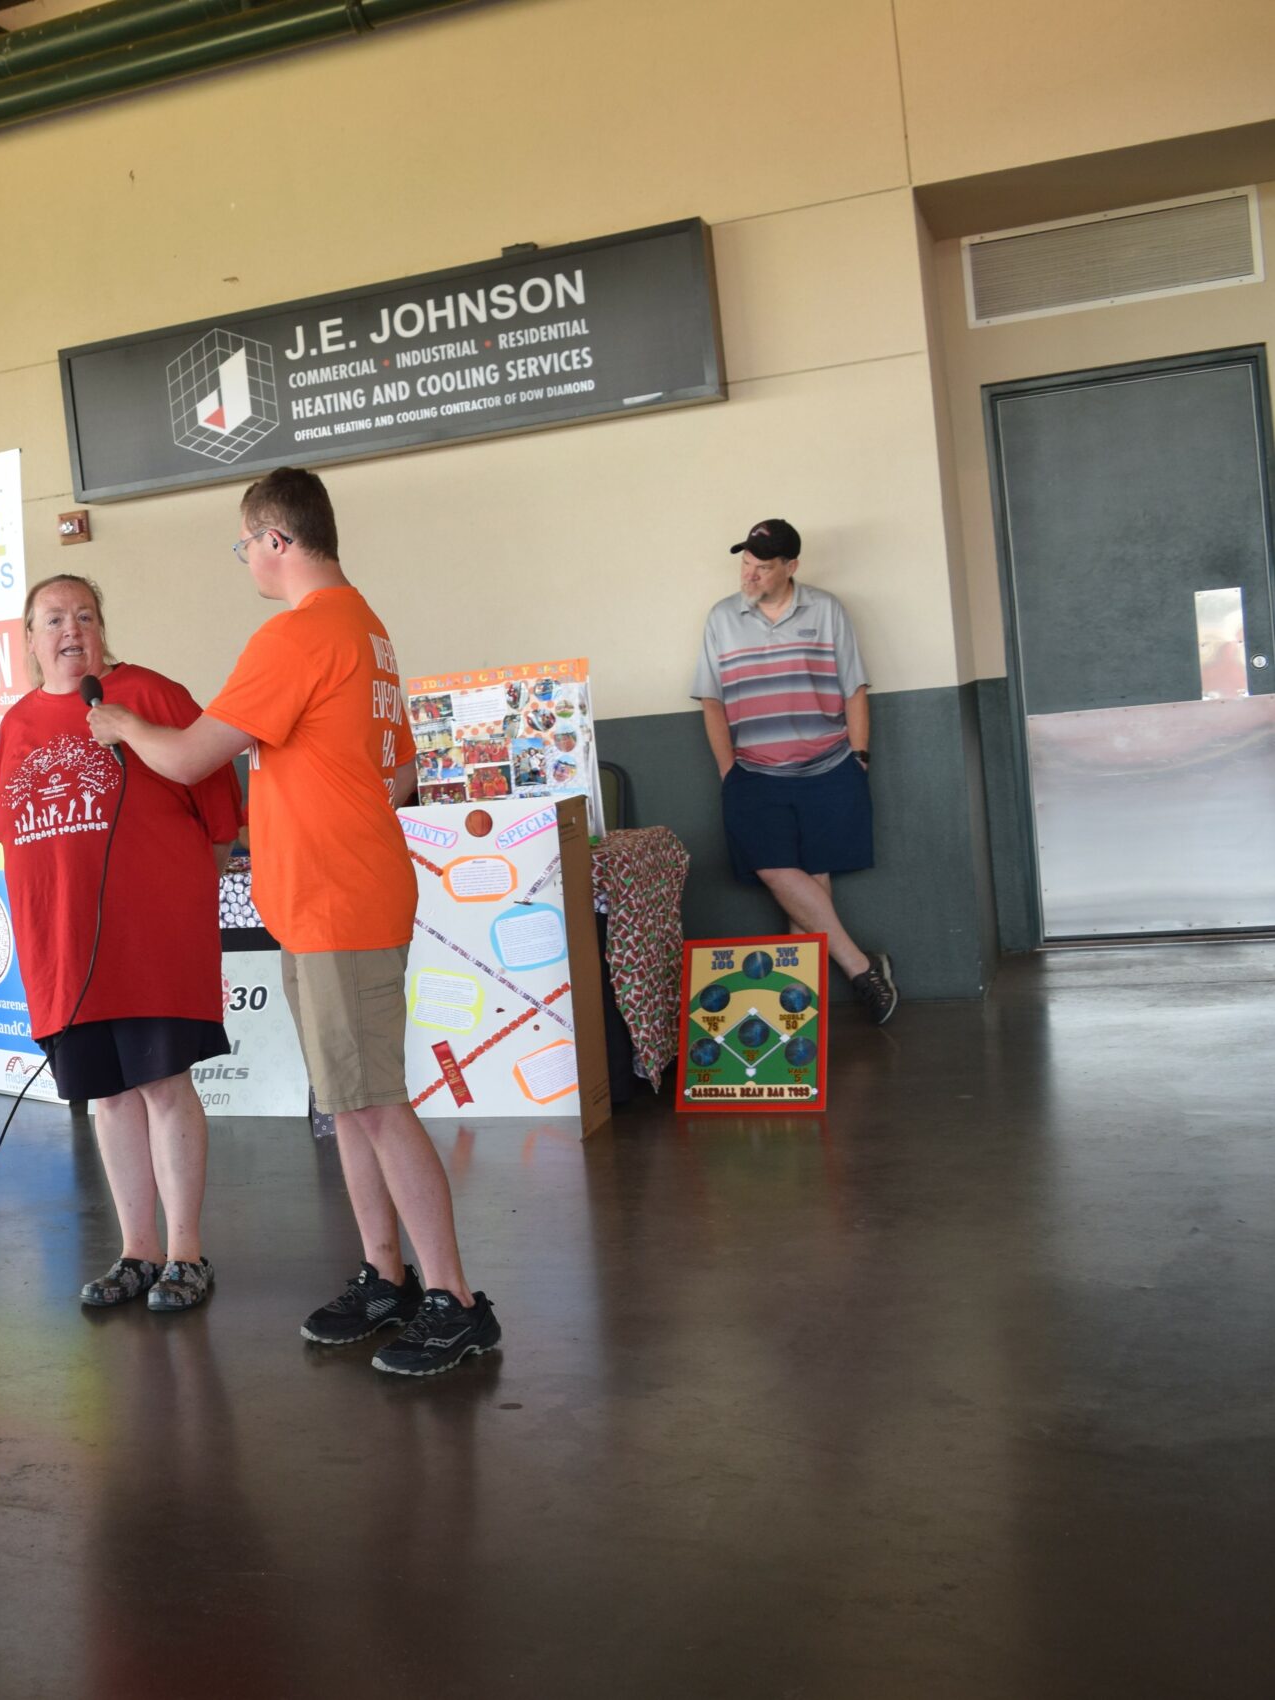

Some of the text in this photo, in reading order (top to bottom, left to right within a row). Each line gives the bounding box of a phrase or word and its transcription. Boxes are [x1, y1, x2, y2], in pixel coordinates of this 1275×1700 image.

[285, 269, 586, 360] J.E. JOHNSON
[288, 318, 589, 389] COMMERCIAL INDUSTRIAL RESIDENTIAL
[291, 347, 593, 420] HEATING AND COOLING SERVICES
[294, 379, 596, 442] OFFICIAL HEATING AND COOLING CONTRACTOR OF DOW DIAMOND
[412, 674, 472, 690] MIDLAD
[479, 666, 529, 683] COUNY
[58, 821, 109, 836] TOGETHER
[229, 986, 268, 1011] 30
[691, 1086, 810, 1098] BASEBALL BEAN BAG TOSS
